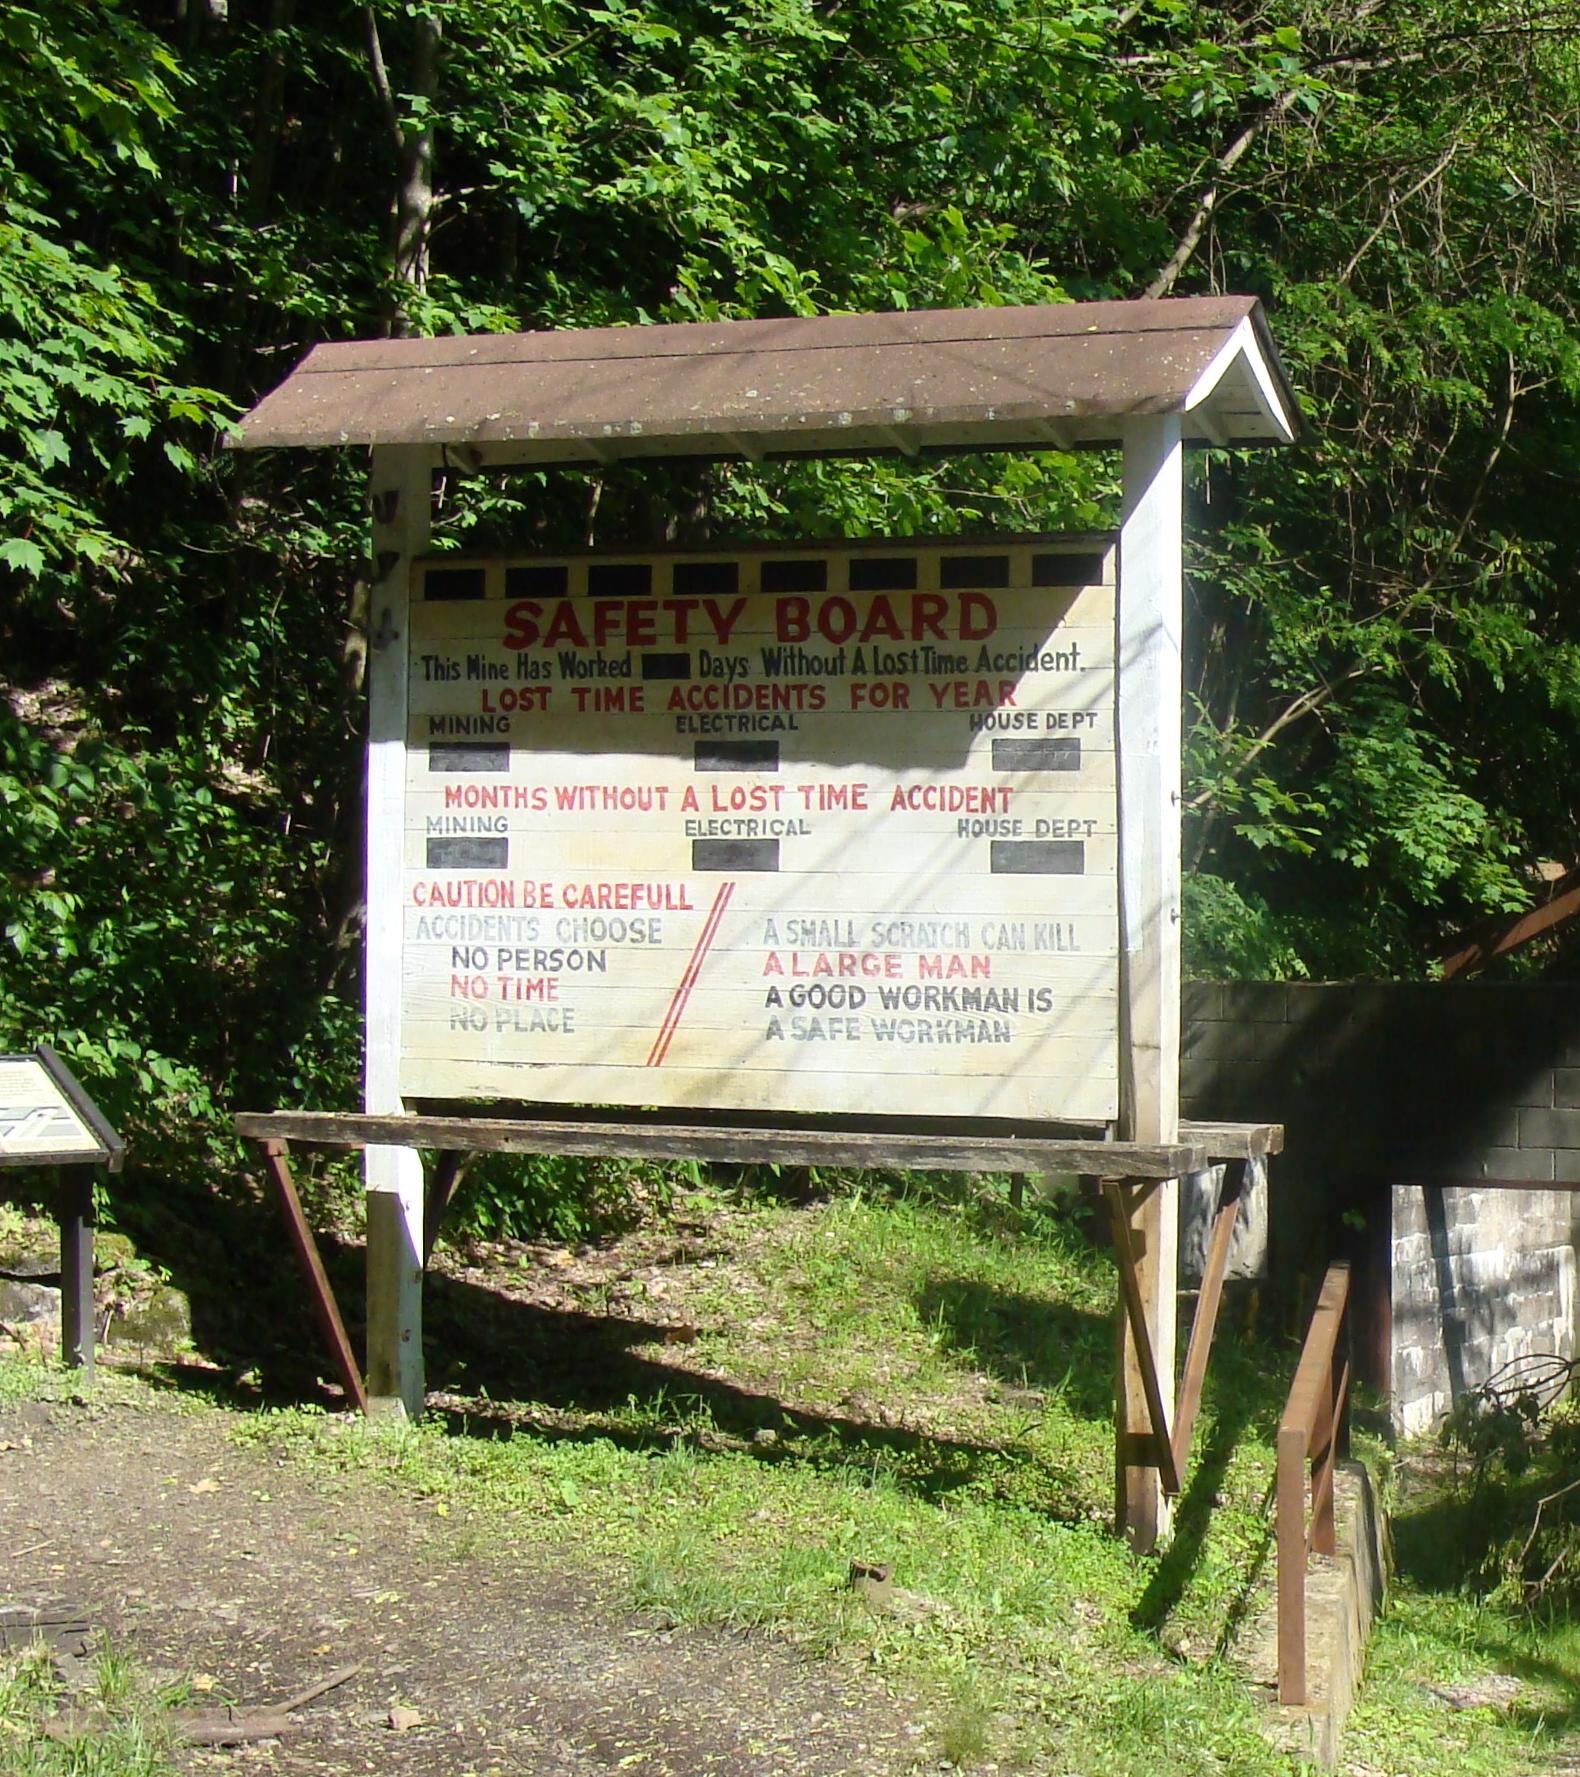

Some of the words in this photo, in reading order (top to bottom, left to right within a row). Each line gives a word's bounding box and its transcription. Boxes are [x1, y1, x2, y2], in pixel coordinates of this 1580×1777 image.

[502, 597, 748, 650] SAFETY
[775, 592, 997, 644] BOARD
[421, 655, 461, 680] This
[467, 654, 510, 680] Mine
[517, 653, 553, 680] Has
[558, 651, 632, 679] Worked
[699, 650, 749, 683] Days
[761, 646, 847, 678] Without
[851, 648, 867, 676] A
[872, 649, 919, 676] Lost
[920, 646, 968, 676] Time
[975, 642, 1087, 674] Accident.
[482, 686, 552, 713] LOST
[571, 686, 645, 712] TIME
[667, 683, 826, 711] ACCIDENTS
[850, 683, 910, 710] FOR
[929, 680, 1018, 709] YEAR
[429, 715, 511, 735] MINING
[676, 713, 799, 734] ELECTRICAL
[969, 712, 1038, 732] HOUSE
[1046, 712, 1098, 731] DEPT
[444, 785, 548, 811] MONTHS
[554, 785, 669, 811] WITHOUT
[680, 786, 700, 812] A
[711, 785, 785, 812] LOST
[797, 783, 869, 811] TIME
[890, 785, 1014, 814] ACCIDENT
[426, 815, 509, 835] MINING
[685, 819, 812, 837] ELECTRICAL
[958, 818, 1023, 838] HOUSE
[1035, 819, 1098, 838] DEPT
[412, 879, 515, 908] CAUTION
[523, 882, 554, 908] BE
[562, 883, 694, 910] CAREFULL
[416, 915, 540, 942] ACCIDENTS
[555, 916, 663, 944] CHOOSE
[763, 918, 780, 946] A
[786, 918, 861, 948] SMALL
[871, 920, 971, 949] SCRATCH
[981, 922, 1026, 951] CAN
[1034, 923, 1081, 952] KILL
[451, 946, 489, 971] NO
[497, 948, 606, 973] PERSON
[763, 951, 785, 977] A
[791, 952, 904, 978] LARGE
[918, 954, 992, 980] MAN
[450, 975, 489, 1000] NO
[497, 976, 560, 1001] TIME
[765, 985, 784, 1009] A
[789, 984, 866, 1010] GOOD
[878, 985, 1019, 1014] WORKMAN
[1028, 987, 1053, 1013] IS
[450, 1006, 489, 1032] NO
[496, 1007, 576, 1034] PLACE
[766, 1015, 785, 1041] A
[791, 1015, 861, 1042] SAFE
[871, 1018, 1012, 1045] WORKMAN
